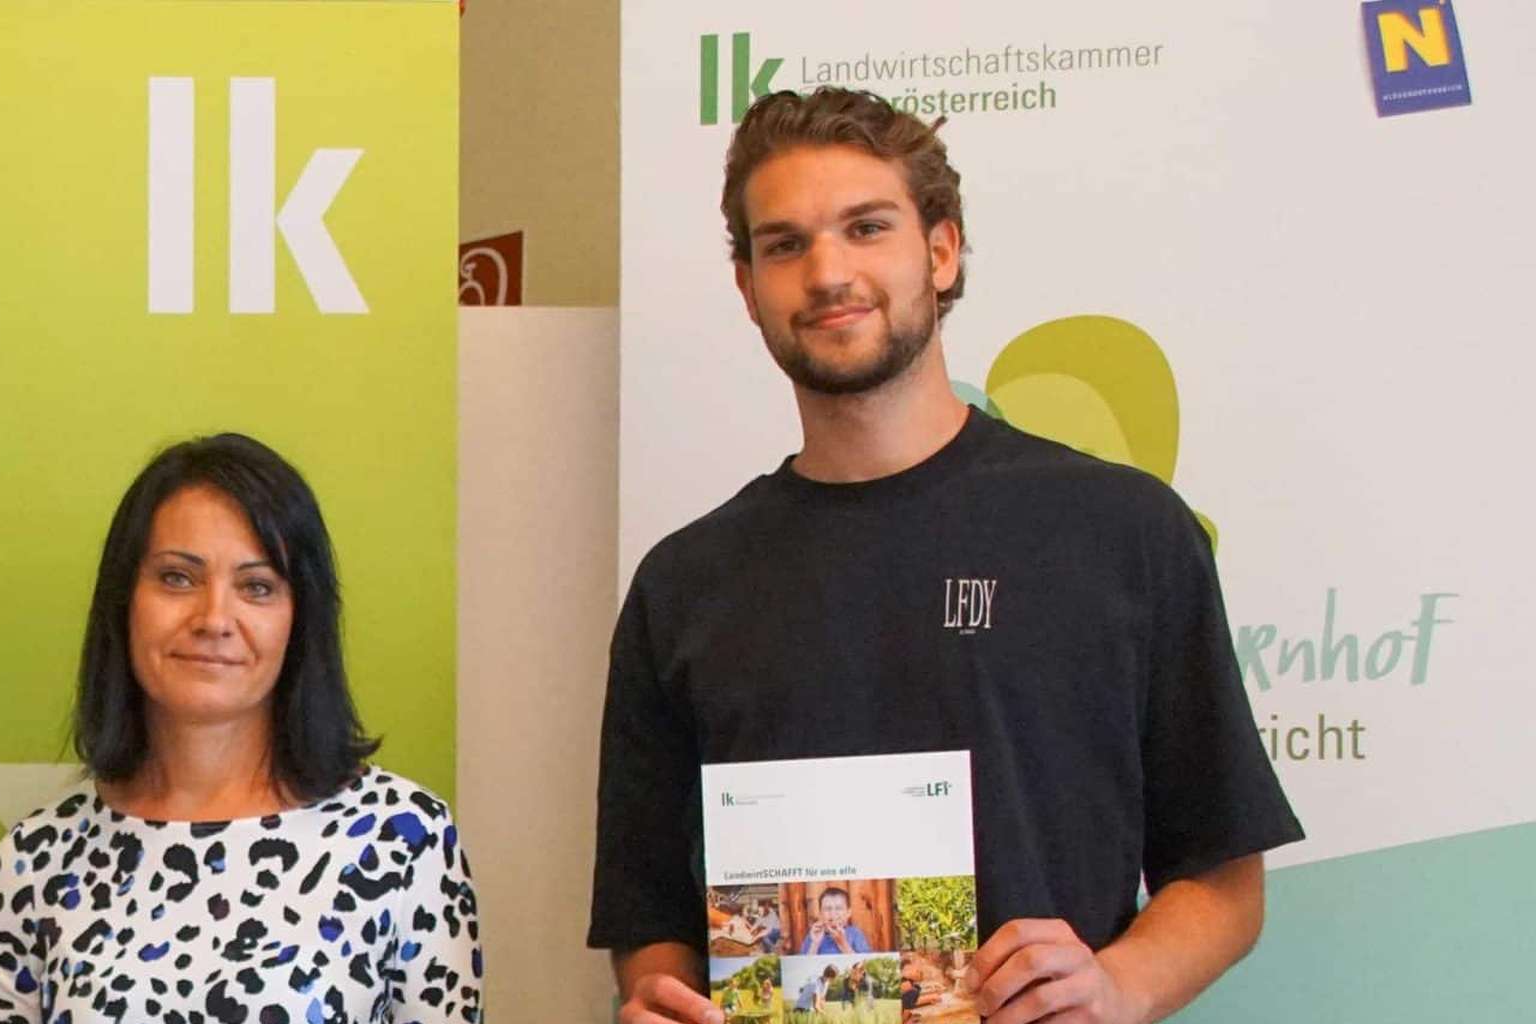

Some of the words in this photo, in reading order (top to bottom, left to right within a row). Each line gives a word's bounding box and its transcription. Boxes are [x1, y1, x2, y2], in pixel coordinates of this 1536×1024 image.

[801, 43, 1164, 84] Landwirtschaftskammer
[1377, 8, 1450, 72] N
[700, 32, 785, 125] lk
[891, 81, 1057, 115] rösterreich
[148, 76, 370, 314] lk
[944, 579, 997, 628] LFDY
